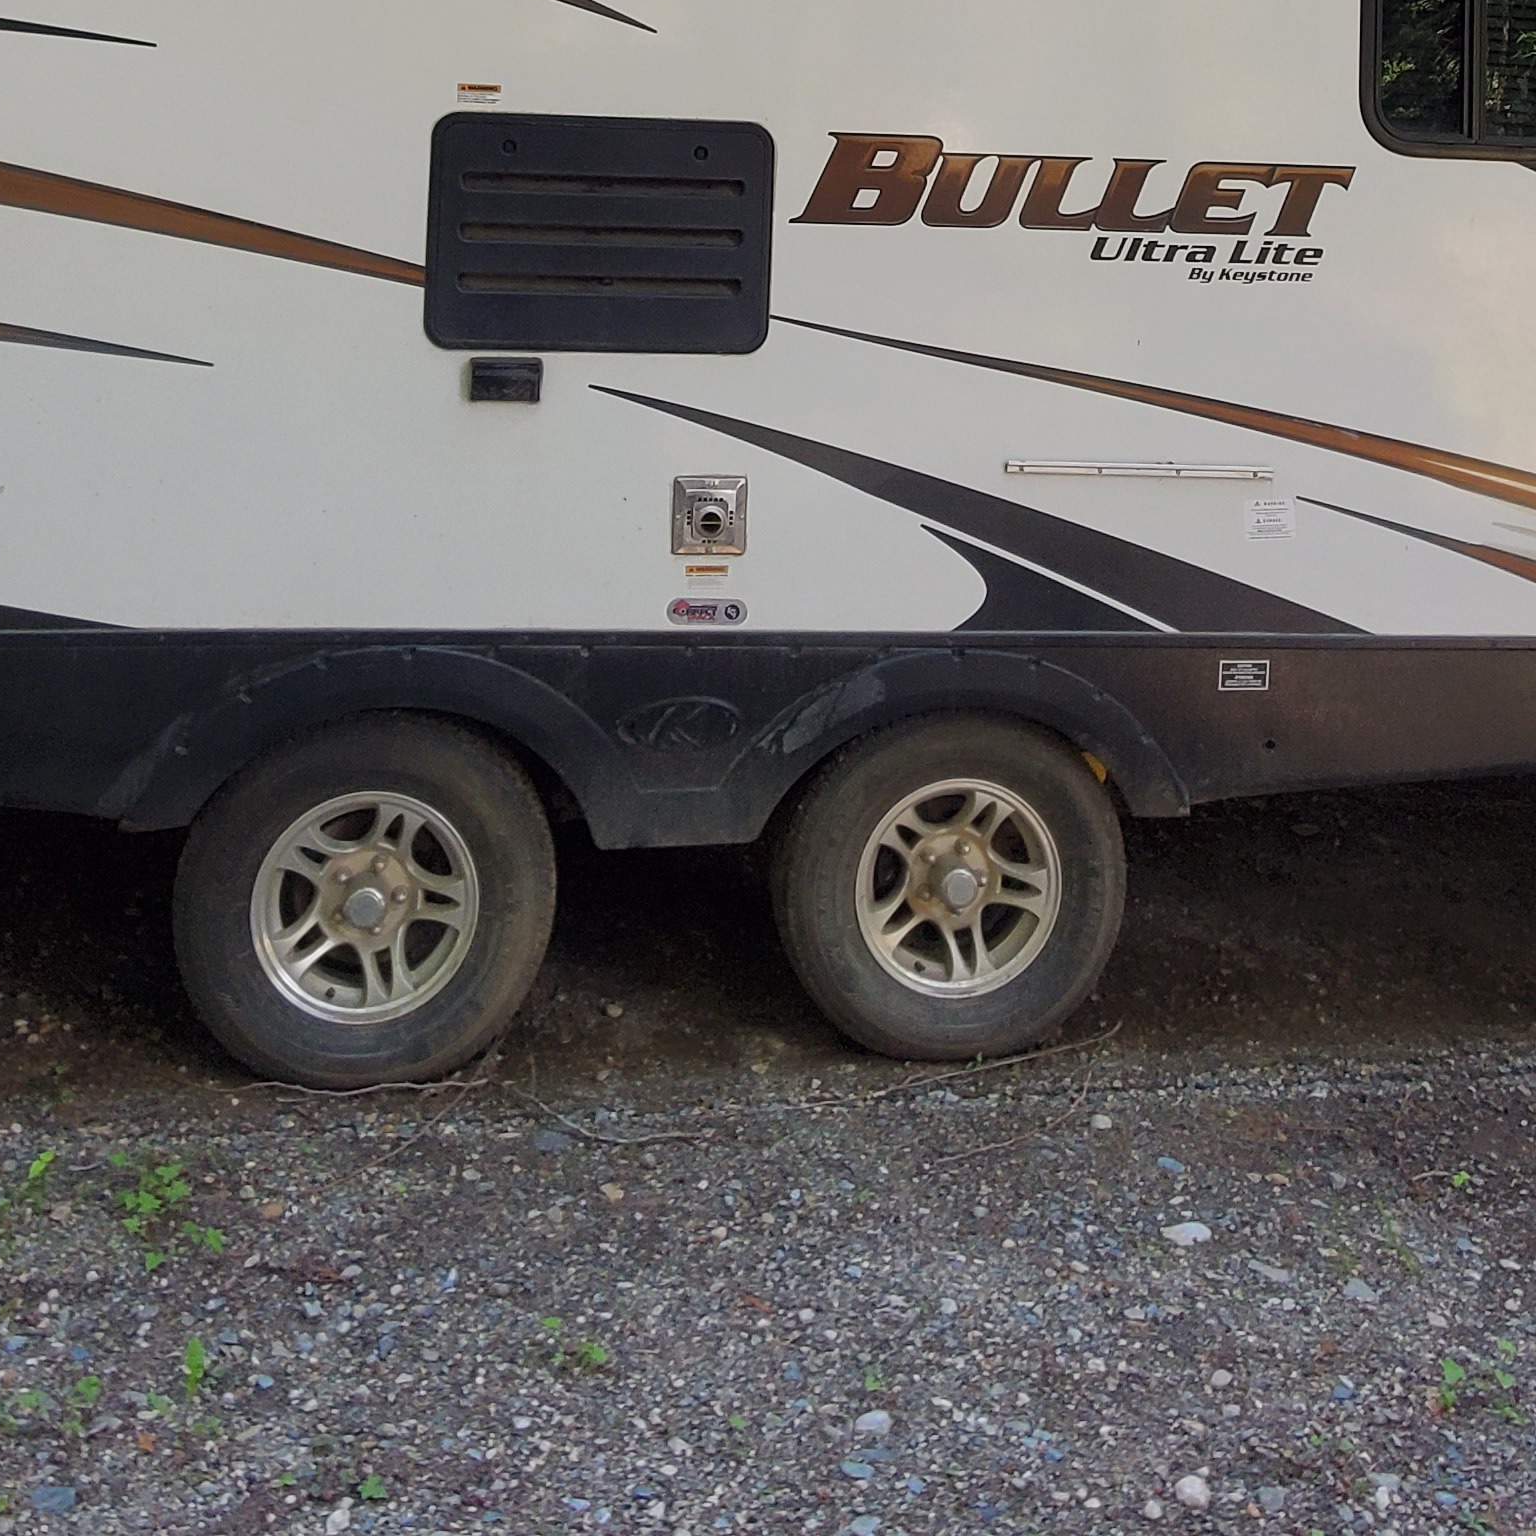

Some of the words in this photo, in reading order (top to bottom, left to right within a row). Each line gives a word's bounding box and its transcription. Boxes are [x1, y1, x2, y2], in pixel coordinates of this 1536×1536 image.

[789, 132, 1356, 237] BULLET
[1090, 237, 1216, 264] Ultra
[1228, 240, 1324, 265] Lite
[1188, 267, 1215, 283] By
[1218, 268, 1313, 284] Keystone
